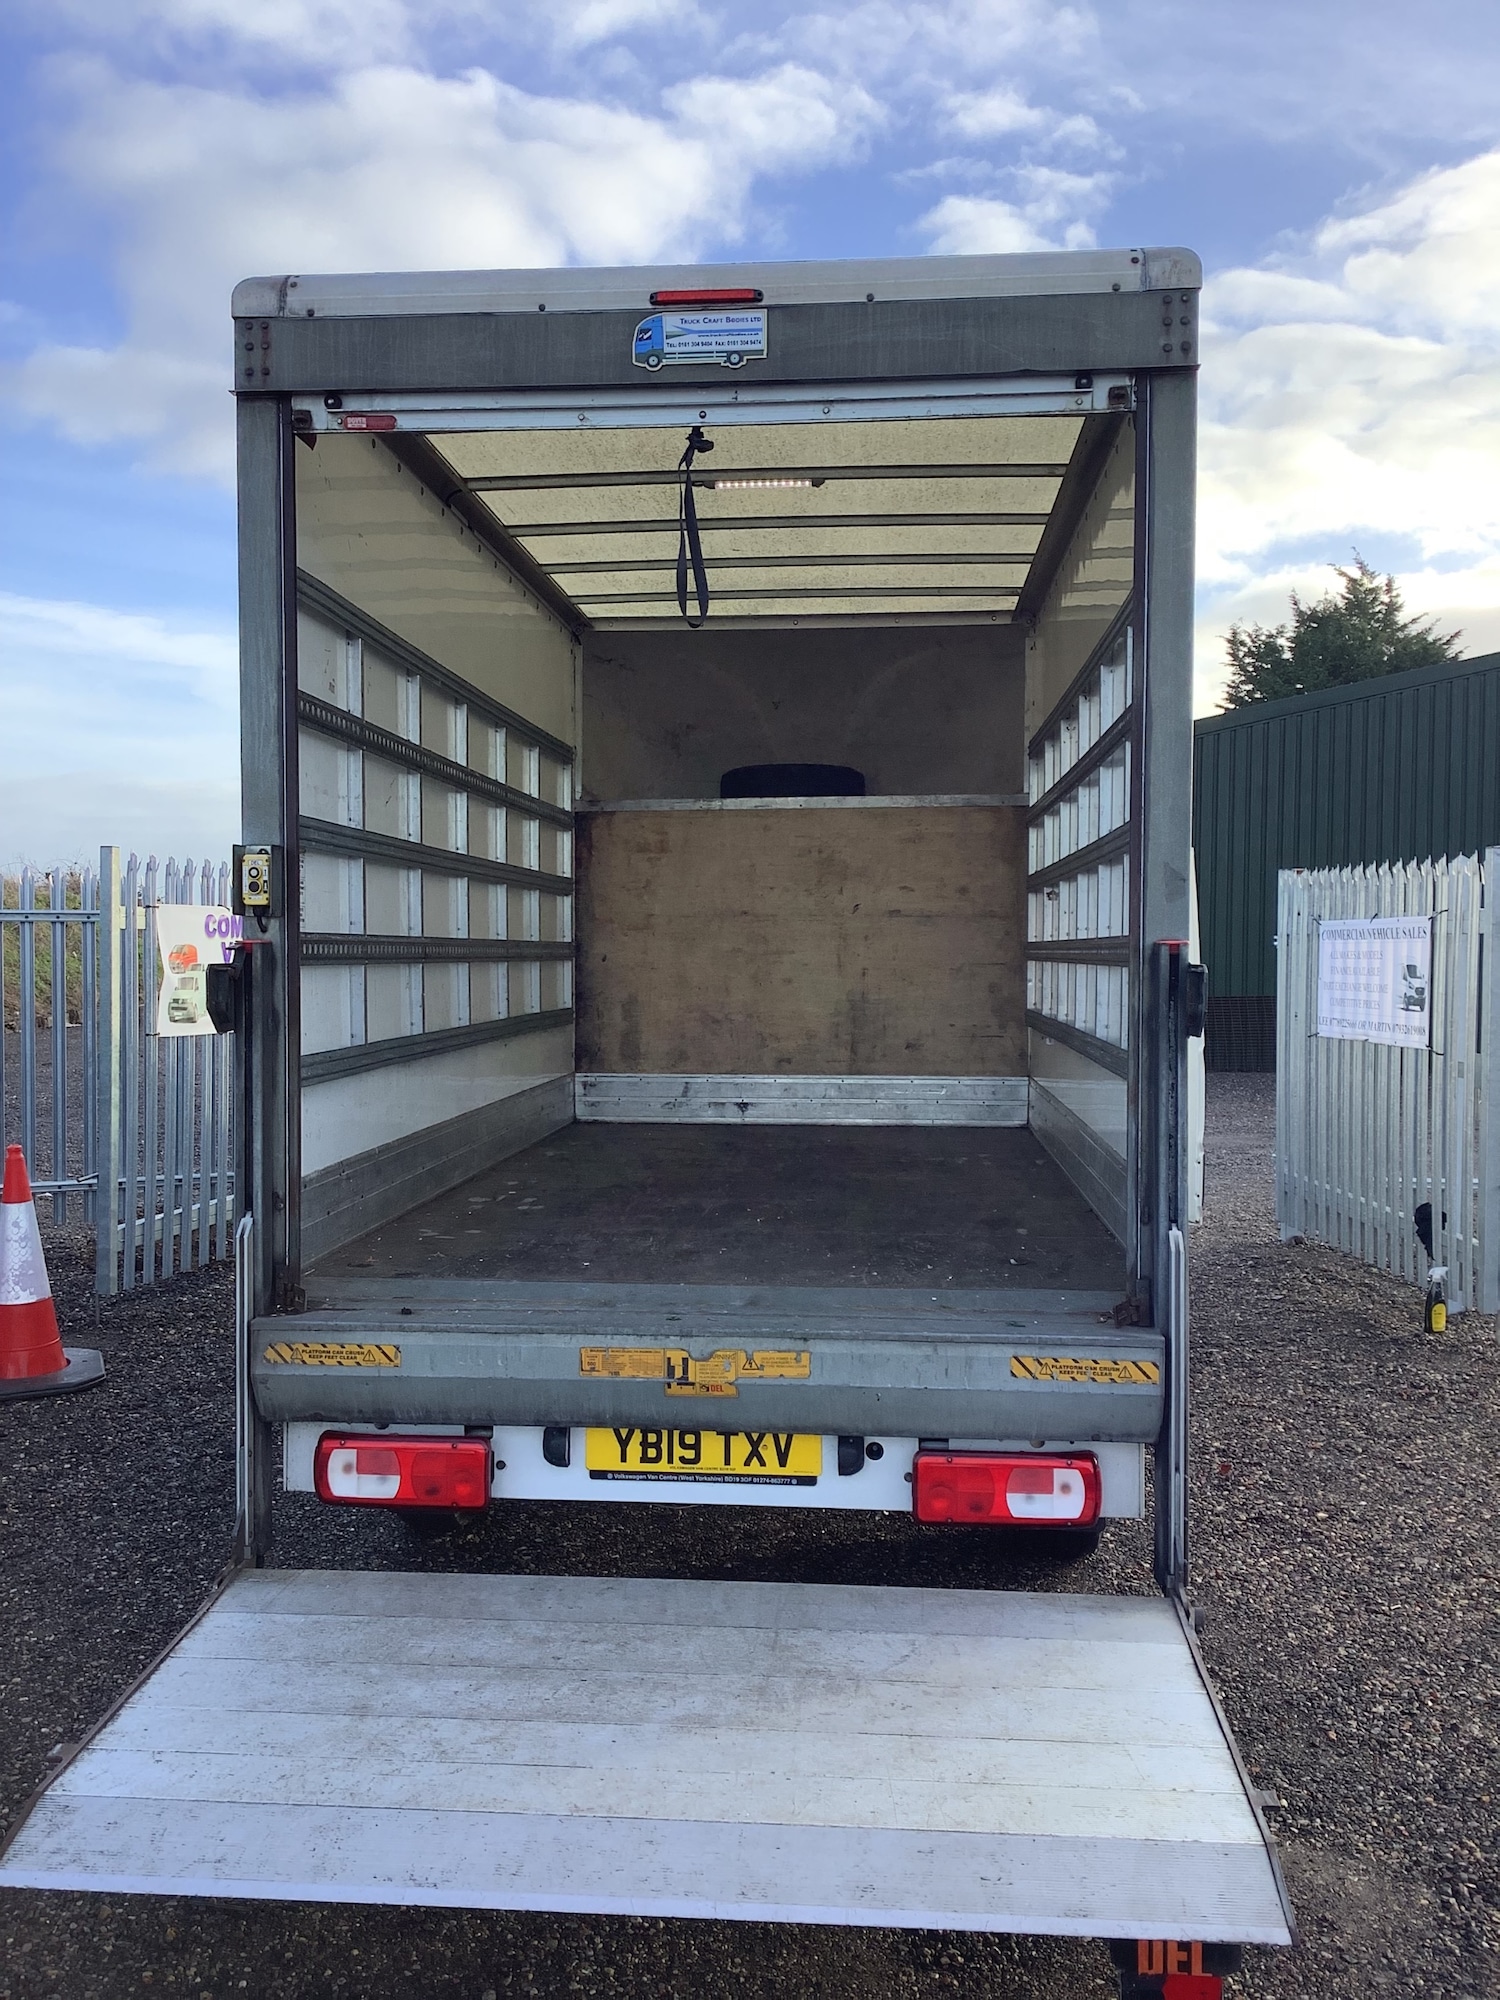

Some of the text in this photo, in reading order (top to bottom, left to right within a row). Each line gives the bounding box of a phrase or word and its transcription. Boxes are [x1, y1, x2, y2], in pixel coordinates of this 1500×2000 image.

[1322, 926, 1428, 941] COMMERCIAL VEHICLE SALES
[1368, 1020, 1391, 1032] MARTIN
[612, 1428, 794, 1468] YB19 TXV
